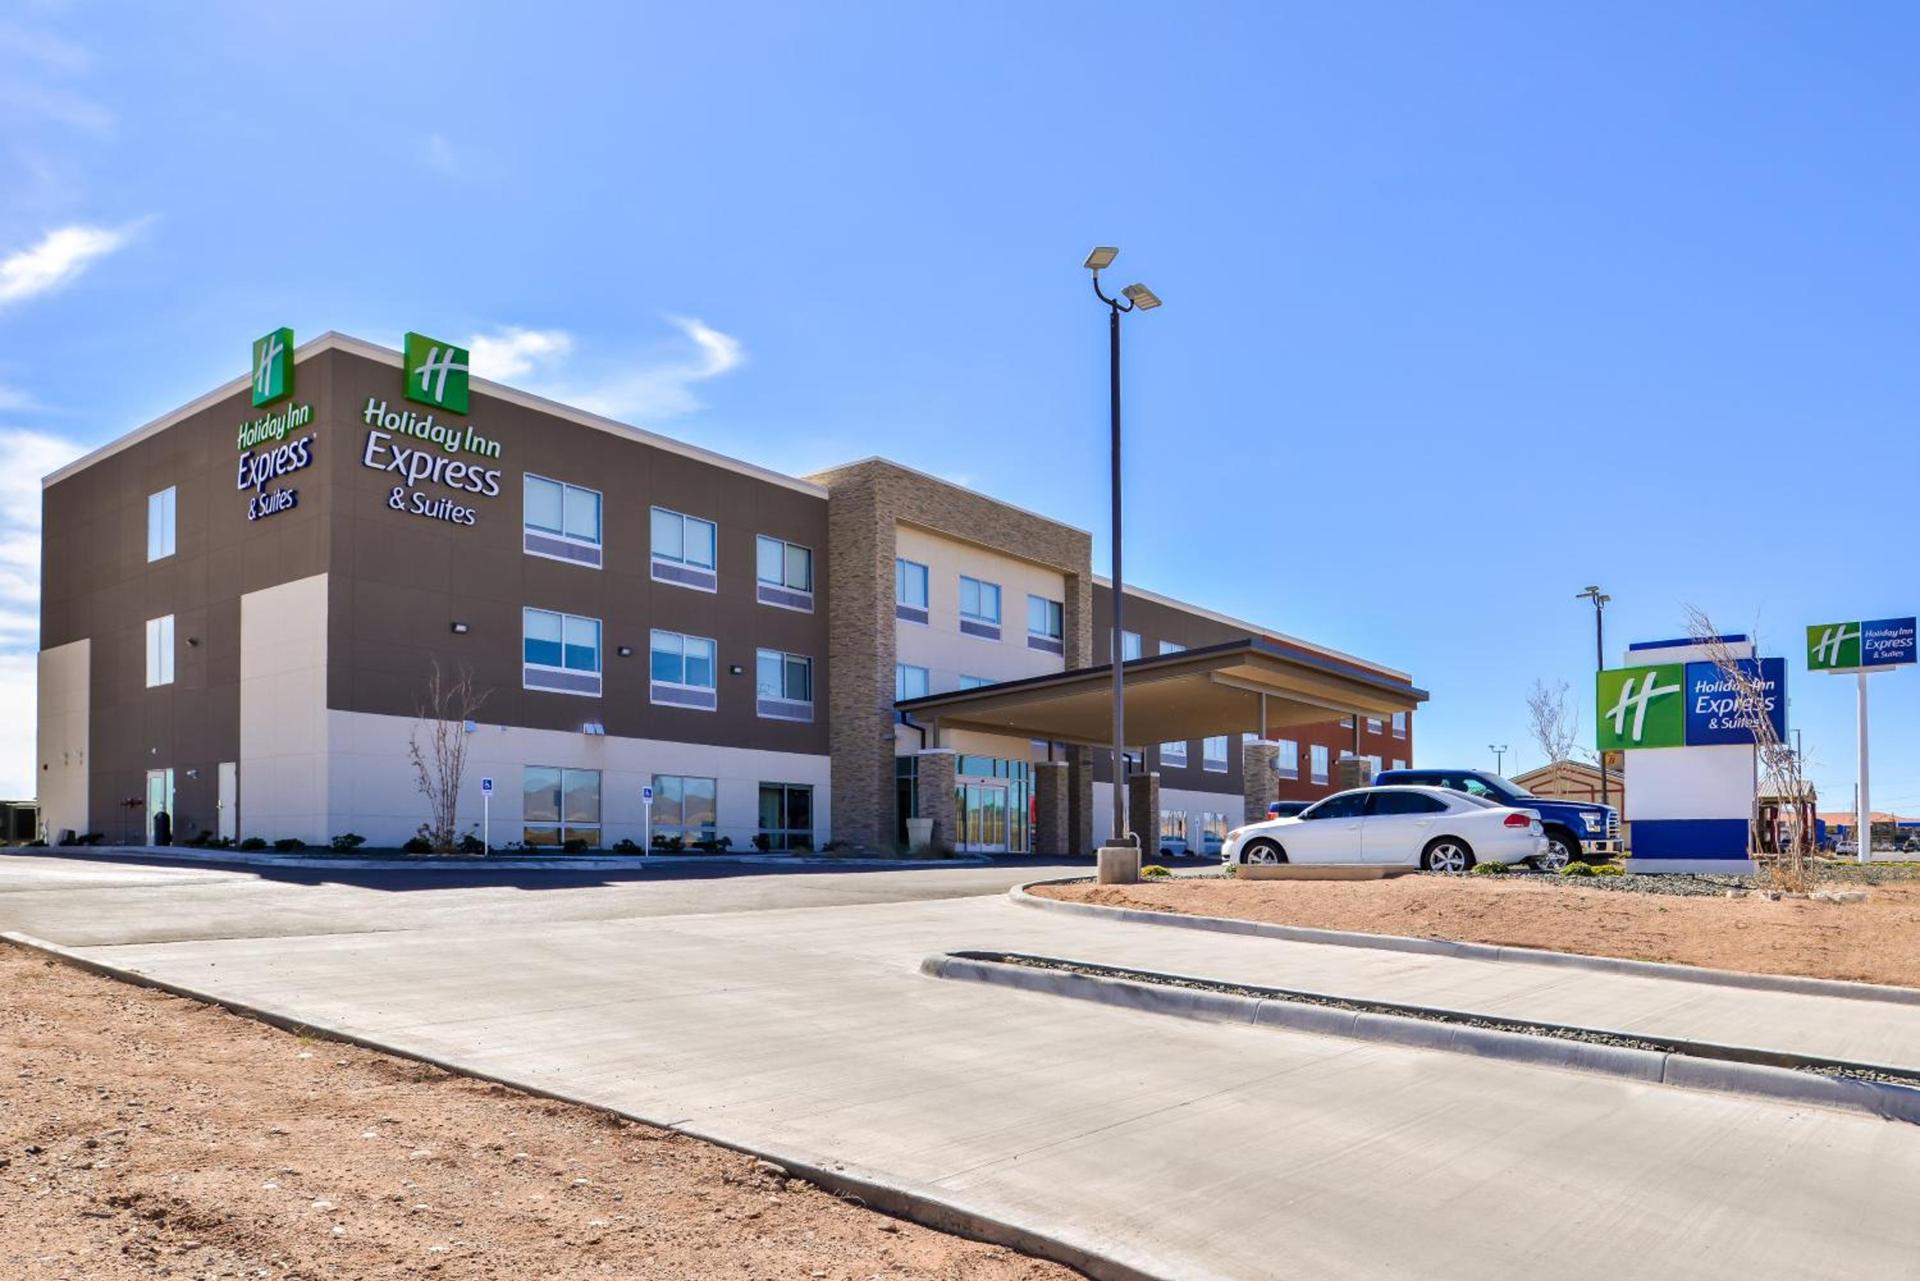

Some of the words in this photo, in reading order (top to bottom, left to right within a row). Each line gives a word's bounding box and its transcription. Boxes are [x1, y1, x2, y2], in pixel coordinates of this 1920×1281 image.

[237, 413, 286, 450] Holiday
[287, 403, 310, 429] Inn
[364, 398, 462, 452] Holiday
[464, 426, 501, 458] Inn
[237, 437, 309, 493] Express
[364, 430, 501, 497] Express
[247, 498, 257, 520] &
[258, 488, 294, 517] Suites
[388, 487, 406, 511] &
[410, 492, 476, 525] Suites
[1865, 629, 1898, 638] Holiday
[1899, 627, 1913, 635] Inn
[1865, 638, 1913, 651] Express
[1695, 680, 1748, 695] Holida
[1708, 717, 1719, 729] &
